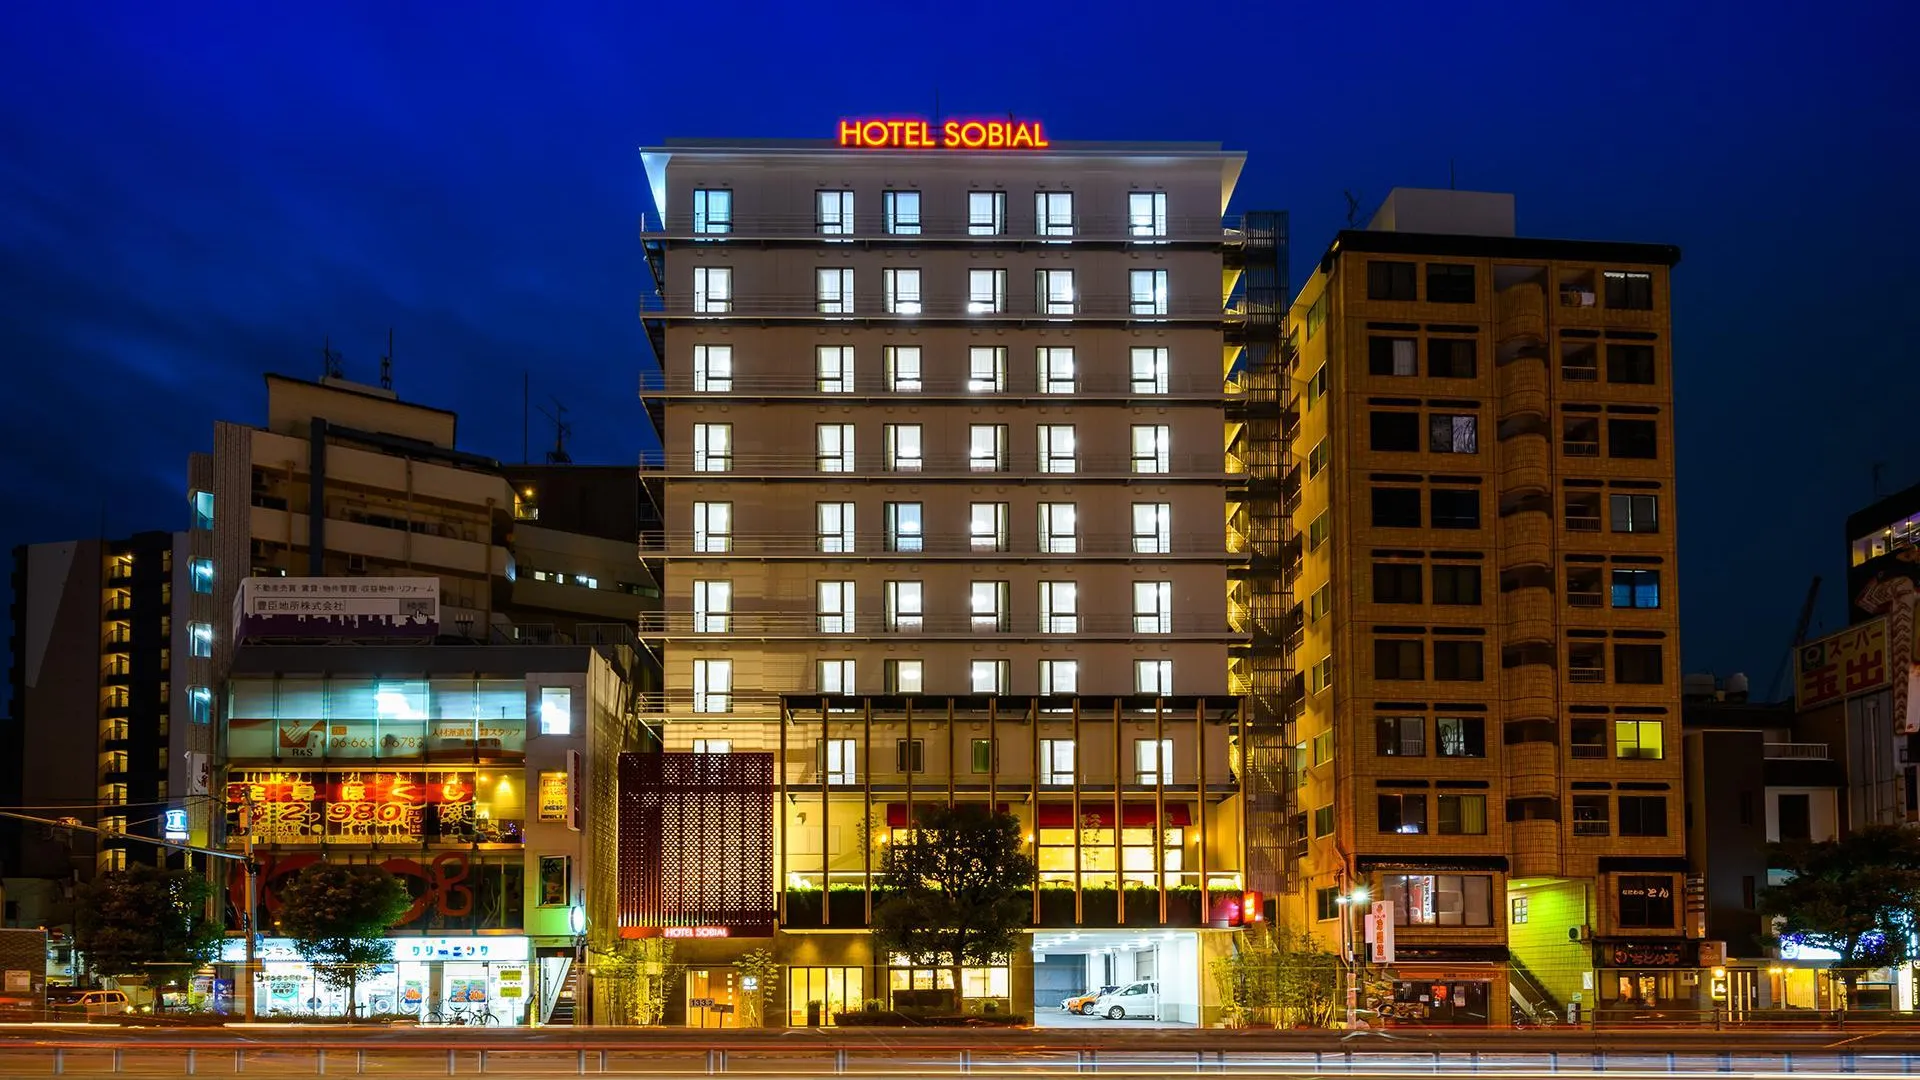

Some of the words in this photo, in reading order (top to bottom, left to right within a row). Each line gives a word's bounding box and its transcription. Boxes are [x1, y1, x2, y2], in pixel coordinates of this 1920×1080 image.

[840, 121, 935, 147] HOTEL
[944, 122, 1048, 148] SOBIAL
[1829, 627, 1883, 659] スーパー
[1801, 650, 1884, 706] 玉出
[291, 748, 313, 757] R&S
[665, 928, 693, 937] HOTEL
[695, 928, 727, 938] SOBIAL
